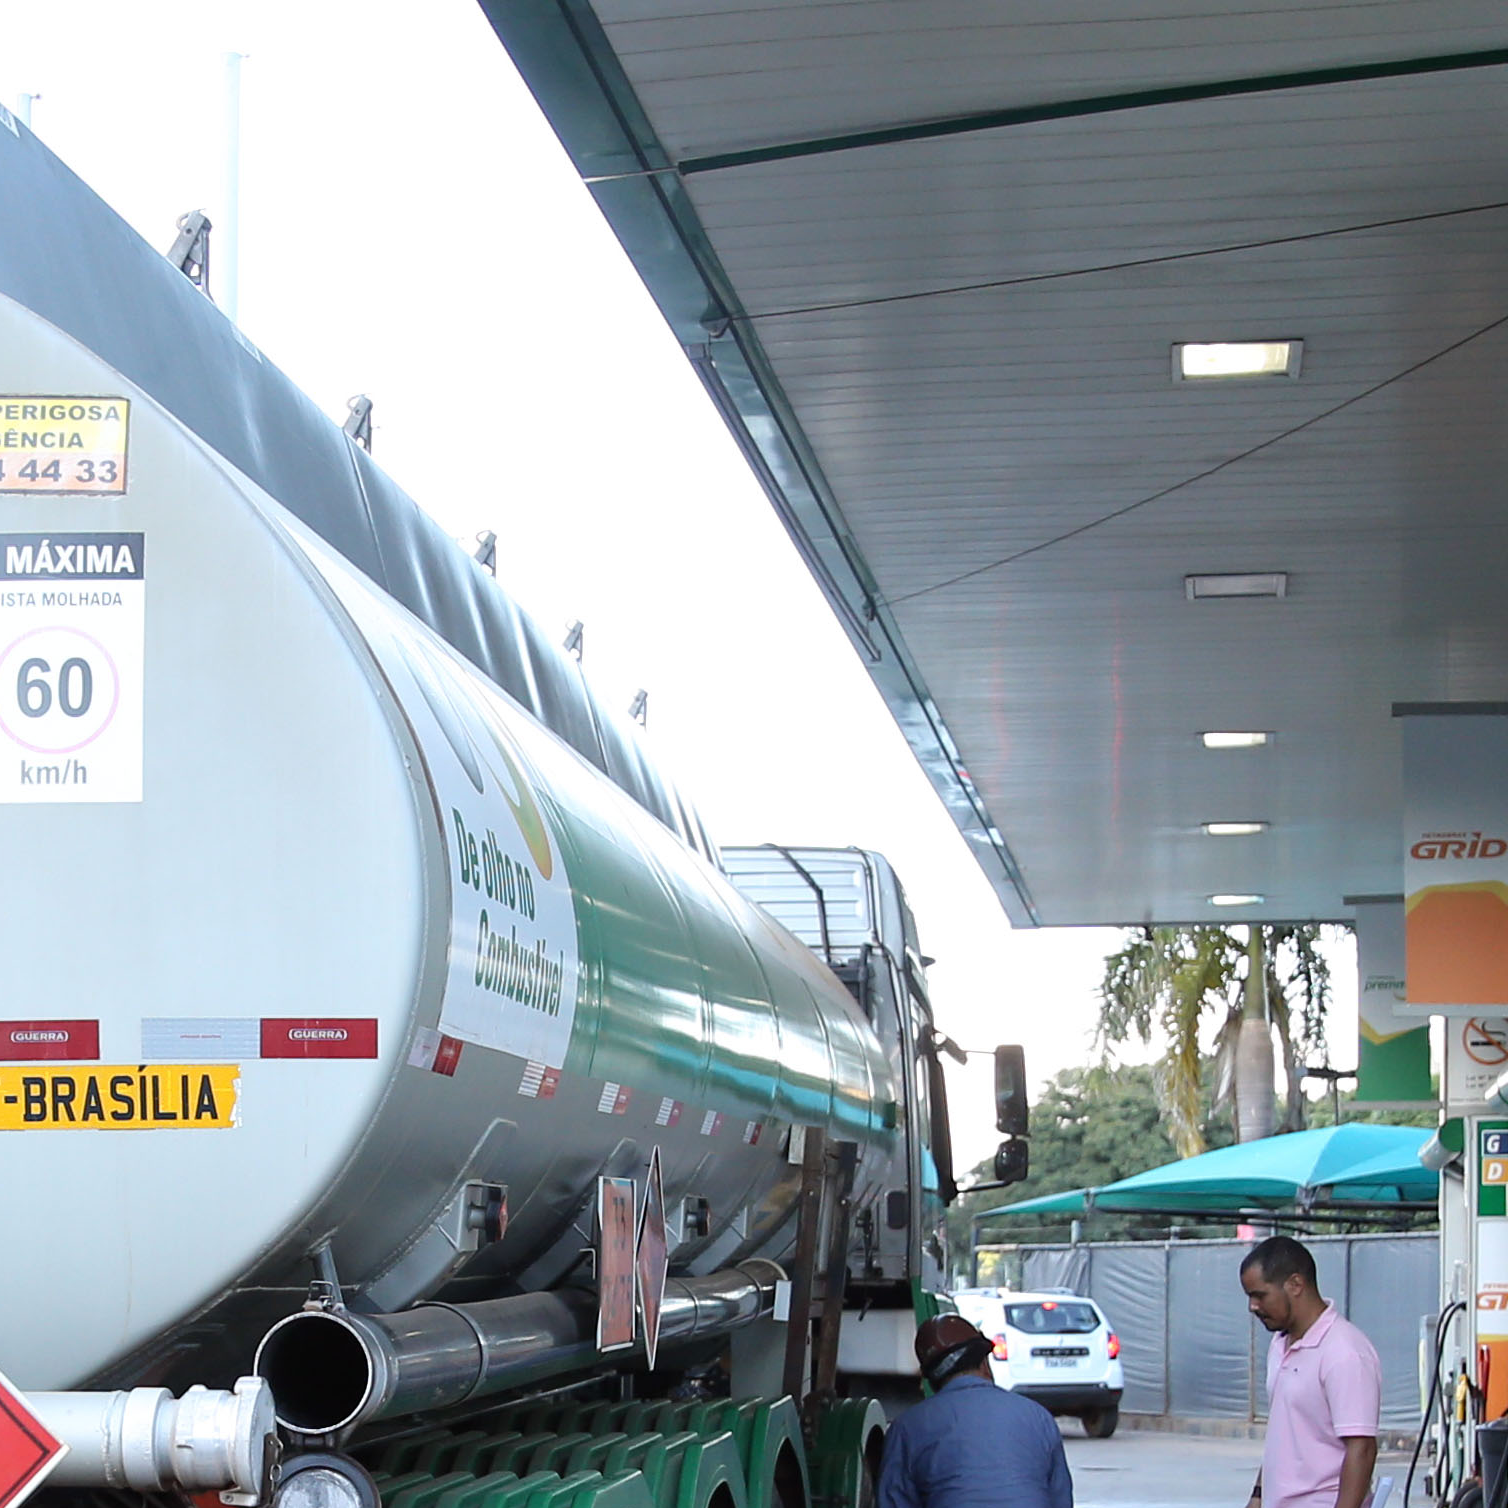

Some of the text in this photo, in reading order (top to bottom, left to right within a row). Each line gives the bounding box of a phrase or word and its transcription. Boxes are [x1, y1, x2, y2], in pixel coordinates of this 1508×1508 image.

[18, 458, 62, 481] 44
[75, 458, 118, 483] 33
[6, 539, 136, 575] MÁXIMA
[42, 591, 122, 607] MOLHADA
[17, 656, 93, 718] 60
[20, 759, 87, 786] km/h
[1410, 832, 1508, 859] GRID
[452, 807, 535, 921] De olho no
[475, 909, 563, 1017] Combustível
[13, 1031, 66, 1042] GUERRA
[292, 1029, 344, 1040] GUERRA
[1487, 1134, 1501, 1153] G
[1487, 1163, 1503, 1181] D
